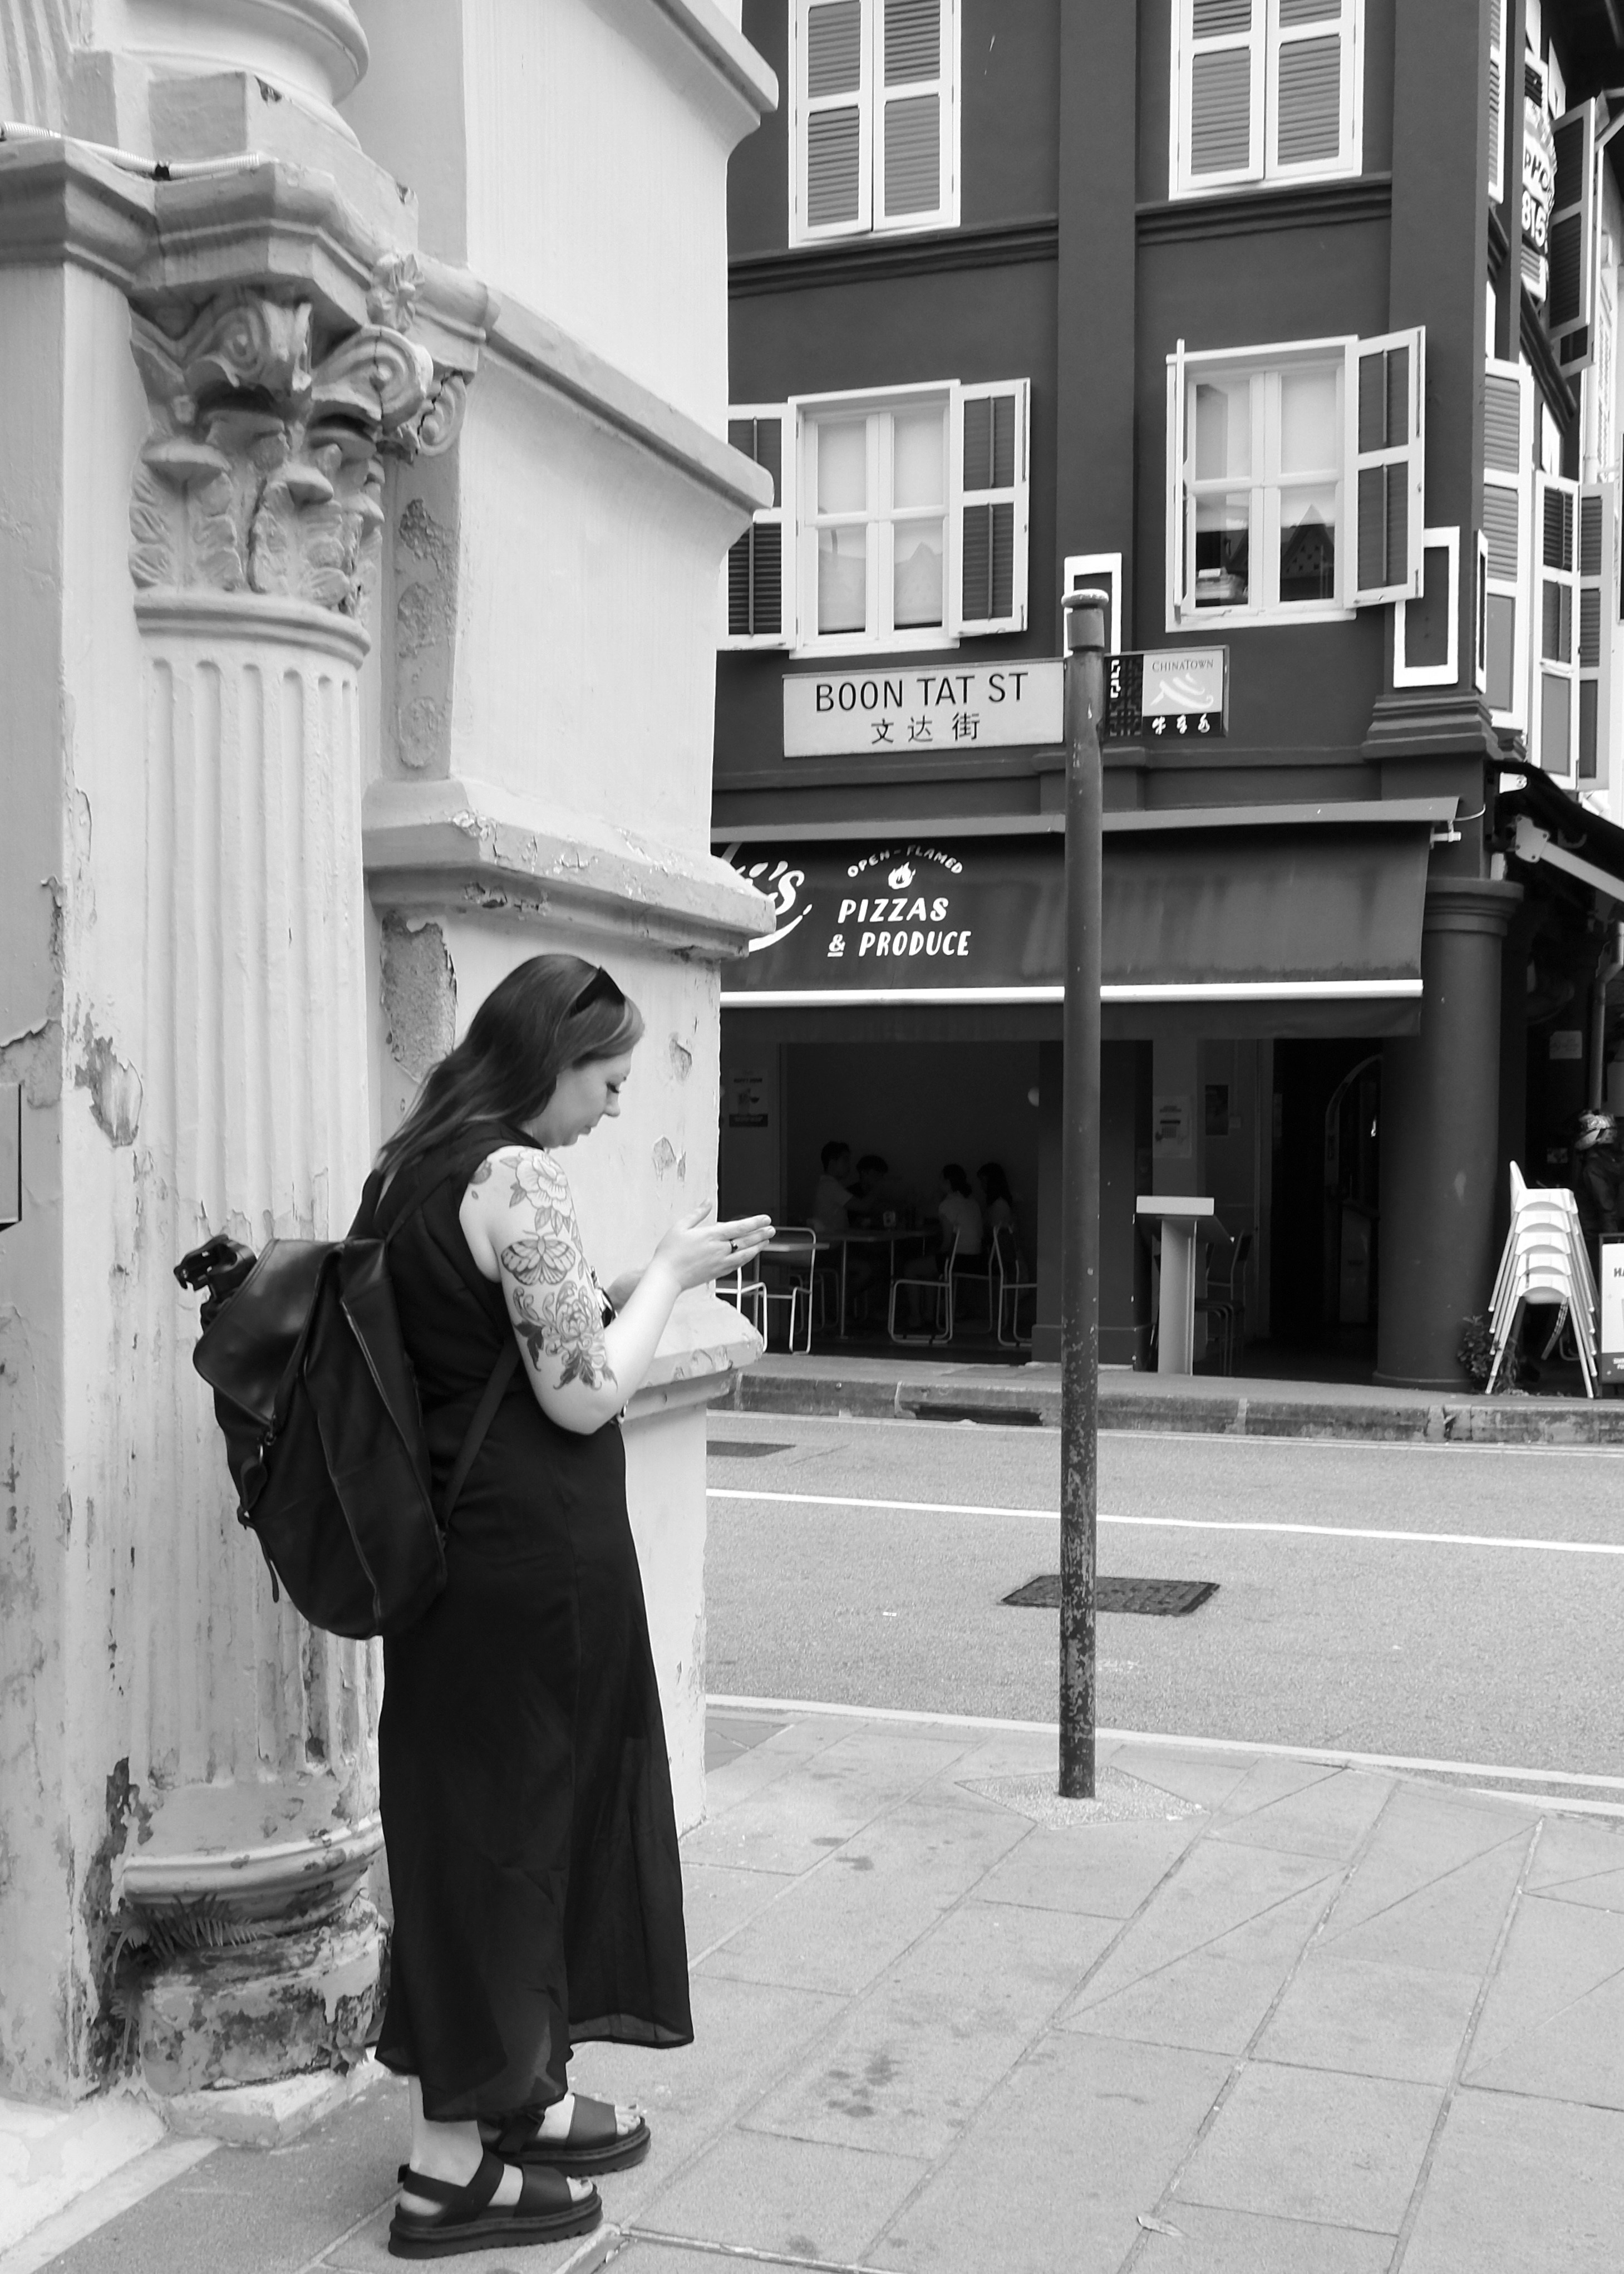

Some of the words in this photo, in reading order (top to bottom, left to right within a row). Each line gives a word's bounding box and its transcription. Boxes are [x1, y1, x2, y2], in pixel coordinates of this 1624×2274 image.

[816, 679, 903, 711] BOON
[917, 676, 975, 705] TAT
[988, 672, 1028, 701] ST
[871, 712, 980, 745] 文达街
[837, 897, 948, 924] PIZZAS
[827, 934, 845, 957] &
[859, 931, 971, 956] PRODUCE
